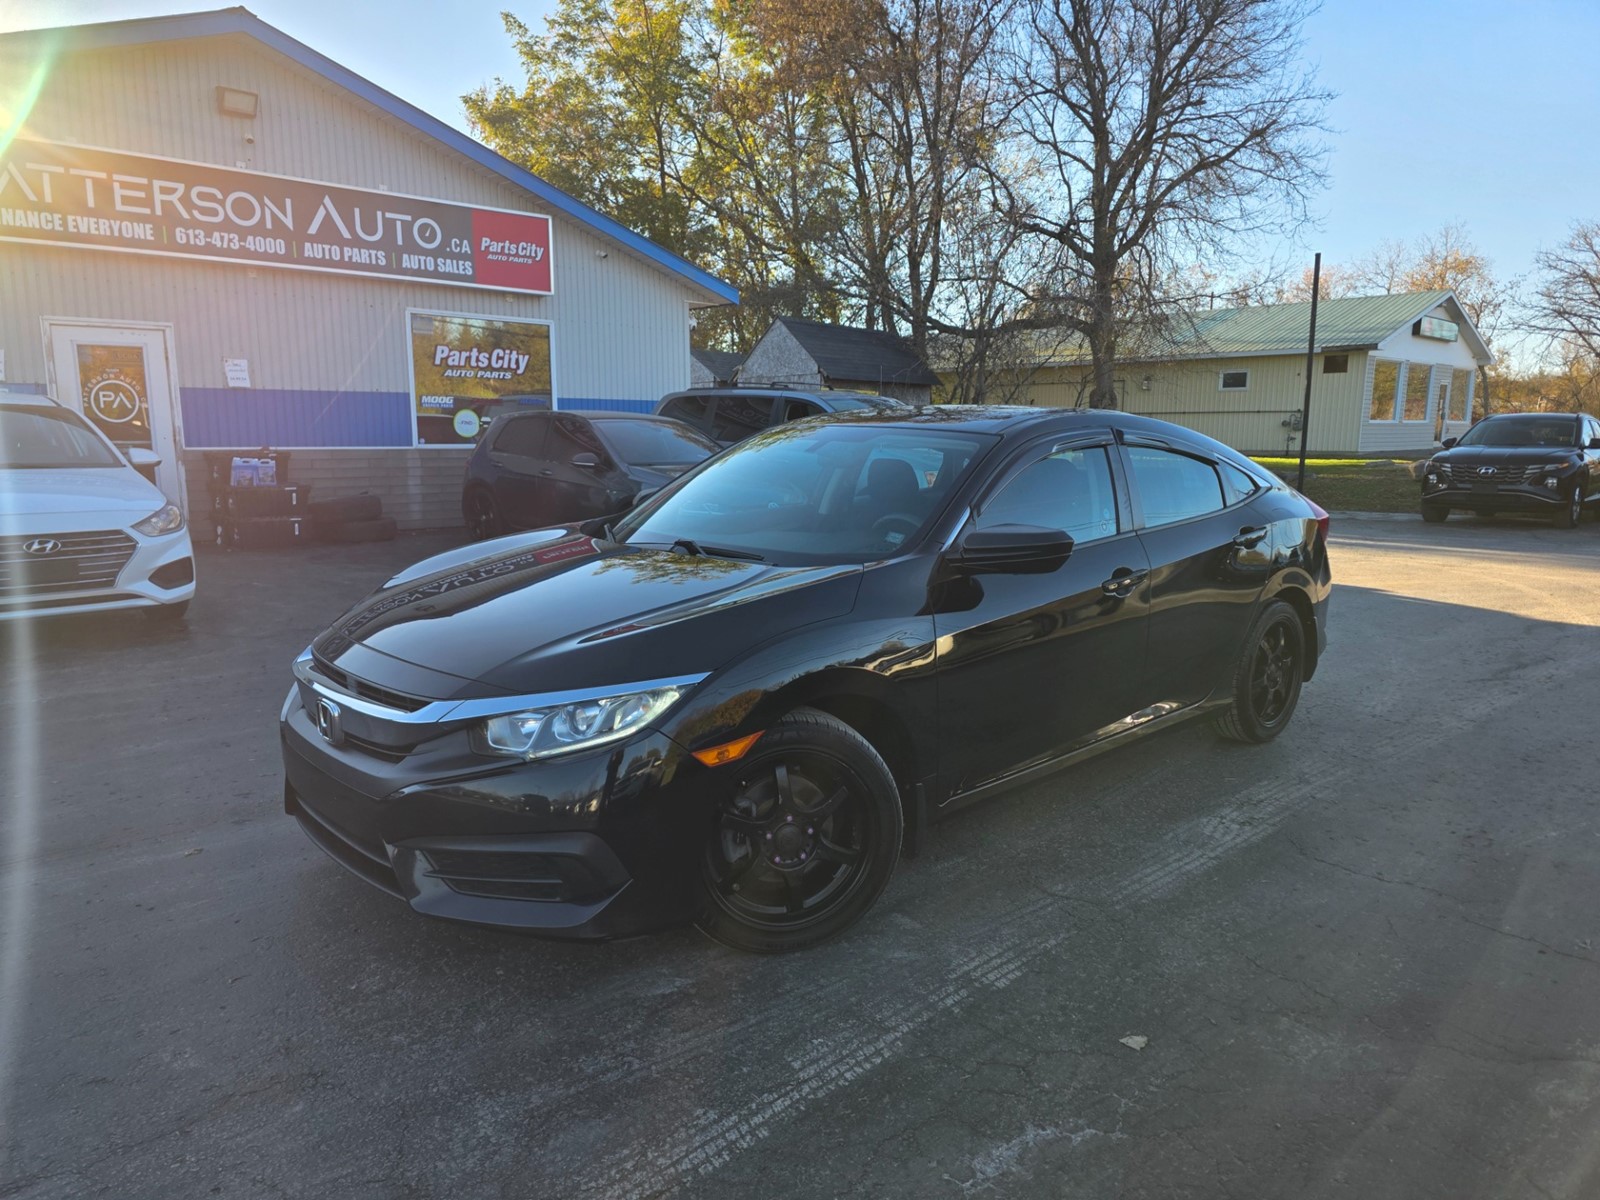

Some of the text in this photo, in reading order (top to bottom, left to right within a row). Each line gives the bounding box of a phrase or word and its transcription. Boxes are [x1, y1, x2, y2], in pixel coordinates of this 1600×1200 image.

[0, 208, 473, 275] NANCE EVERYONE 613-473-4000 AUTO PARTS AUTO SALES
[509, 256, 533, 264] PARTS
[444, 369, 513, 379] AUTO PARTS
[421, 395, 454, 404] MOOG
